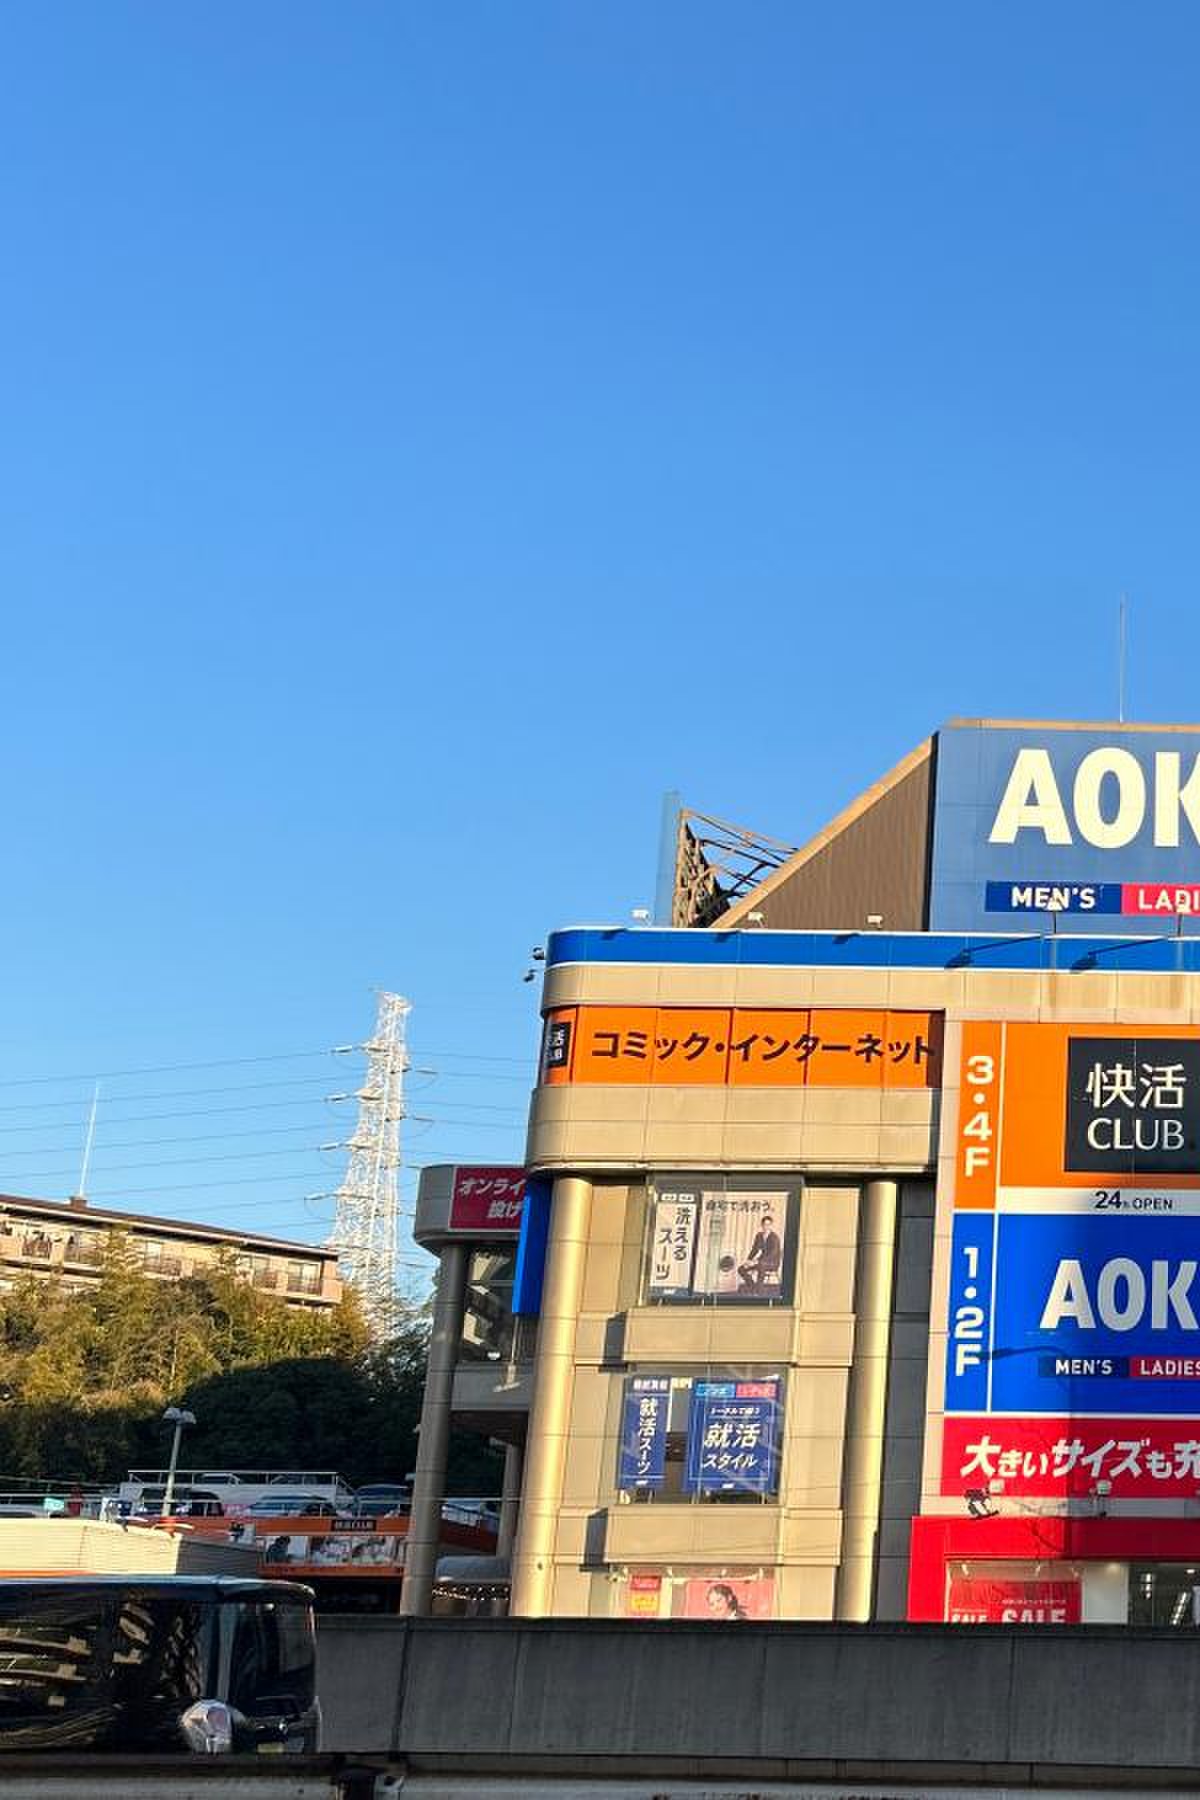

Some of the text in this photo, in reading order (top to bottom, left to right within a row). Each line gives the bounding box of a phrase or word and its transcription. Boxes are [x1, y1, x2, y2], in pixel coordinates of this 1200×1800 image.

[1011, 887, 1095, 909] MEN'S
[592, 1031, 934, 1064] コミック・インターネット
[1086, 1062, 1187, 1109] 快活
[1087, 1118, 1185, 1150] CLUB
[1132, 1198, 1173, 1209] OPEN
[1055, 1359, 1113, 1376] MEN'S
[703, 1423, 761, 1449] 就活
[703, 1453, 758, 1469] スタイル
